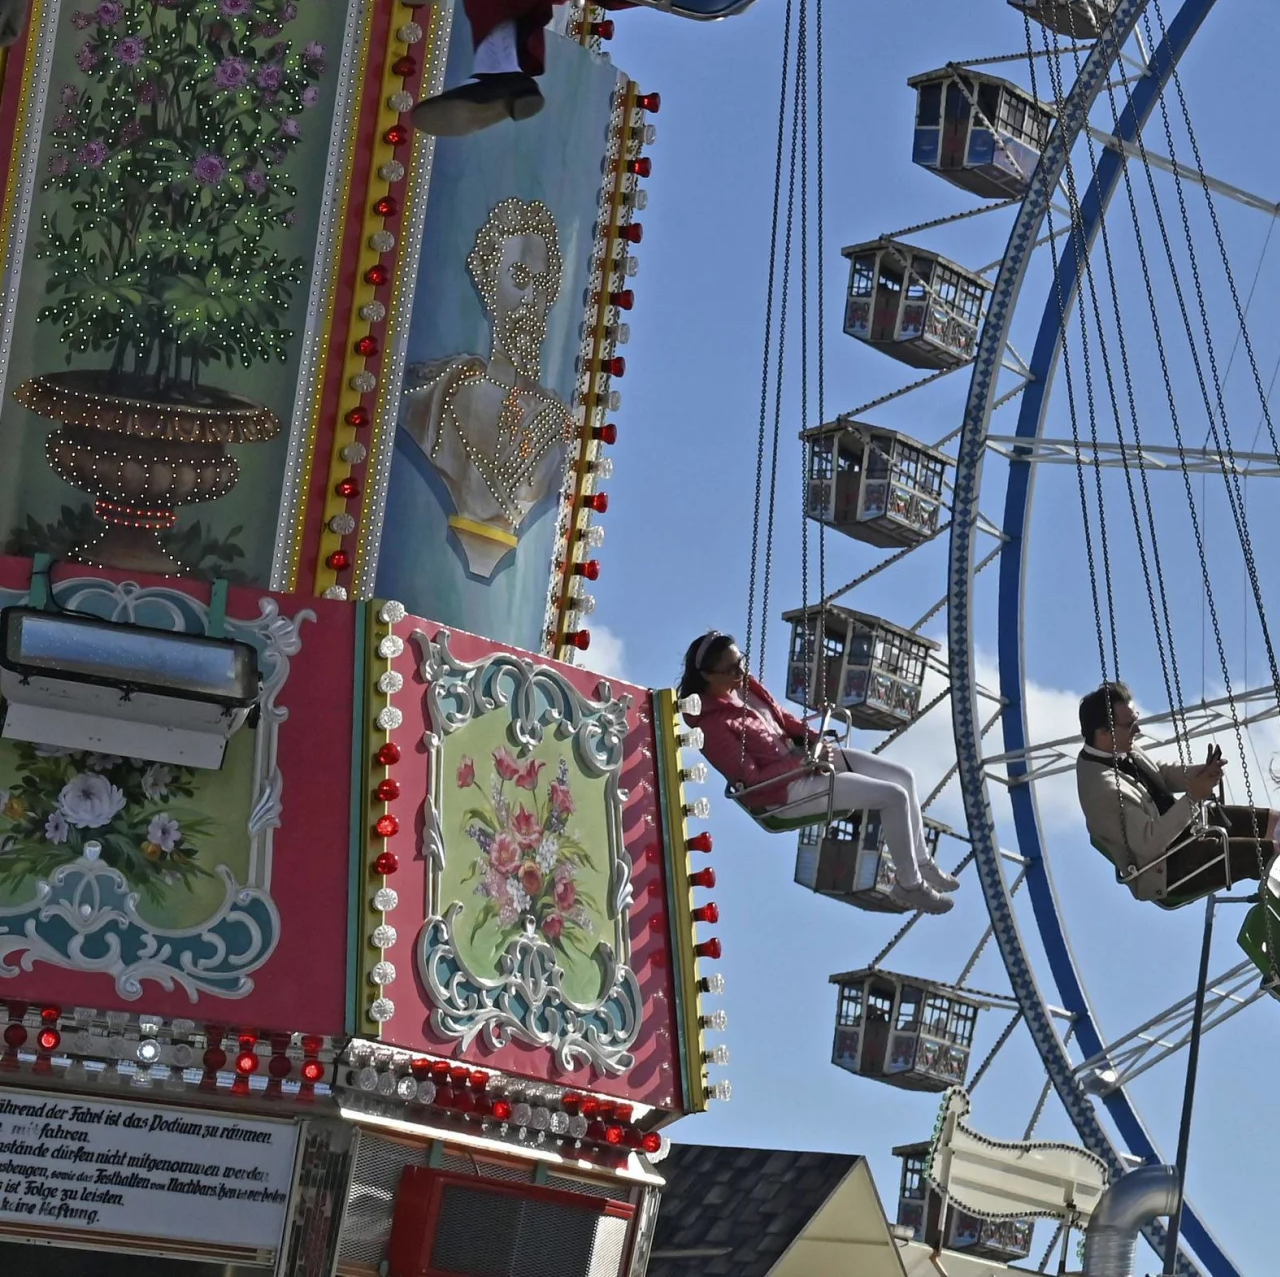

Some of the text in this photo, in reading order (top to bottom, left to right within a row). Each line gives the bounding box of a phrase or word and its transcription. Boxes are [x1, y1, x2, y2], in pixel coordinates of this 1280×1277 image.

[46, 1104, 68, 1119] der
[104, 1110, 122, 1126] ist
[123, 1113, 149, 1129] das
[149, 1114, 202, 1135] Podium
[202, 1125, 219, 1139] zu
[51, 1144, 95, 1163] dürfen
[95, 1149, 127, 1166] nicht
[127, 1153, 220, 1176] mitgenommen
[4, 1179, 22, 1194] ist
[24, 1180, 59, 1200] Folge
[60, 1188, 78, 1202] zu
[80, 1186, 124, 1206] leisten.
[51, 1169, 76, 1181] sowie
[76, 1171, 94, 1183] das
[94, 1168, 151, 1189] Festhalten
